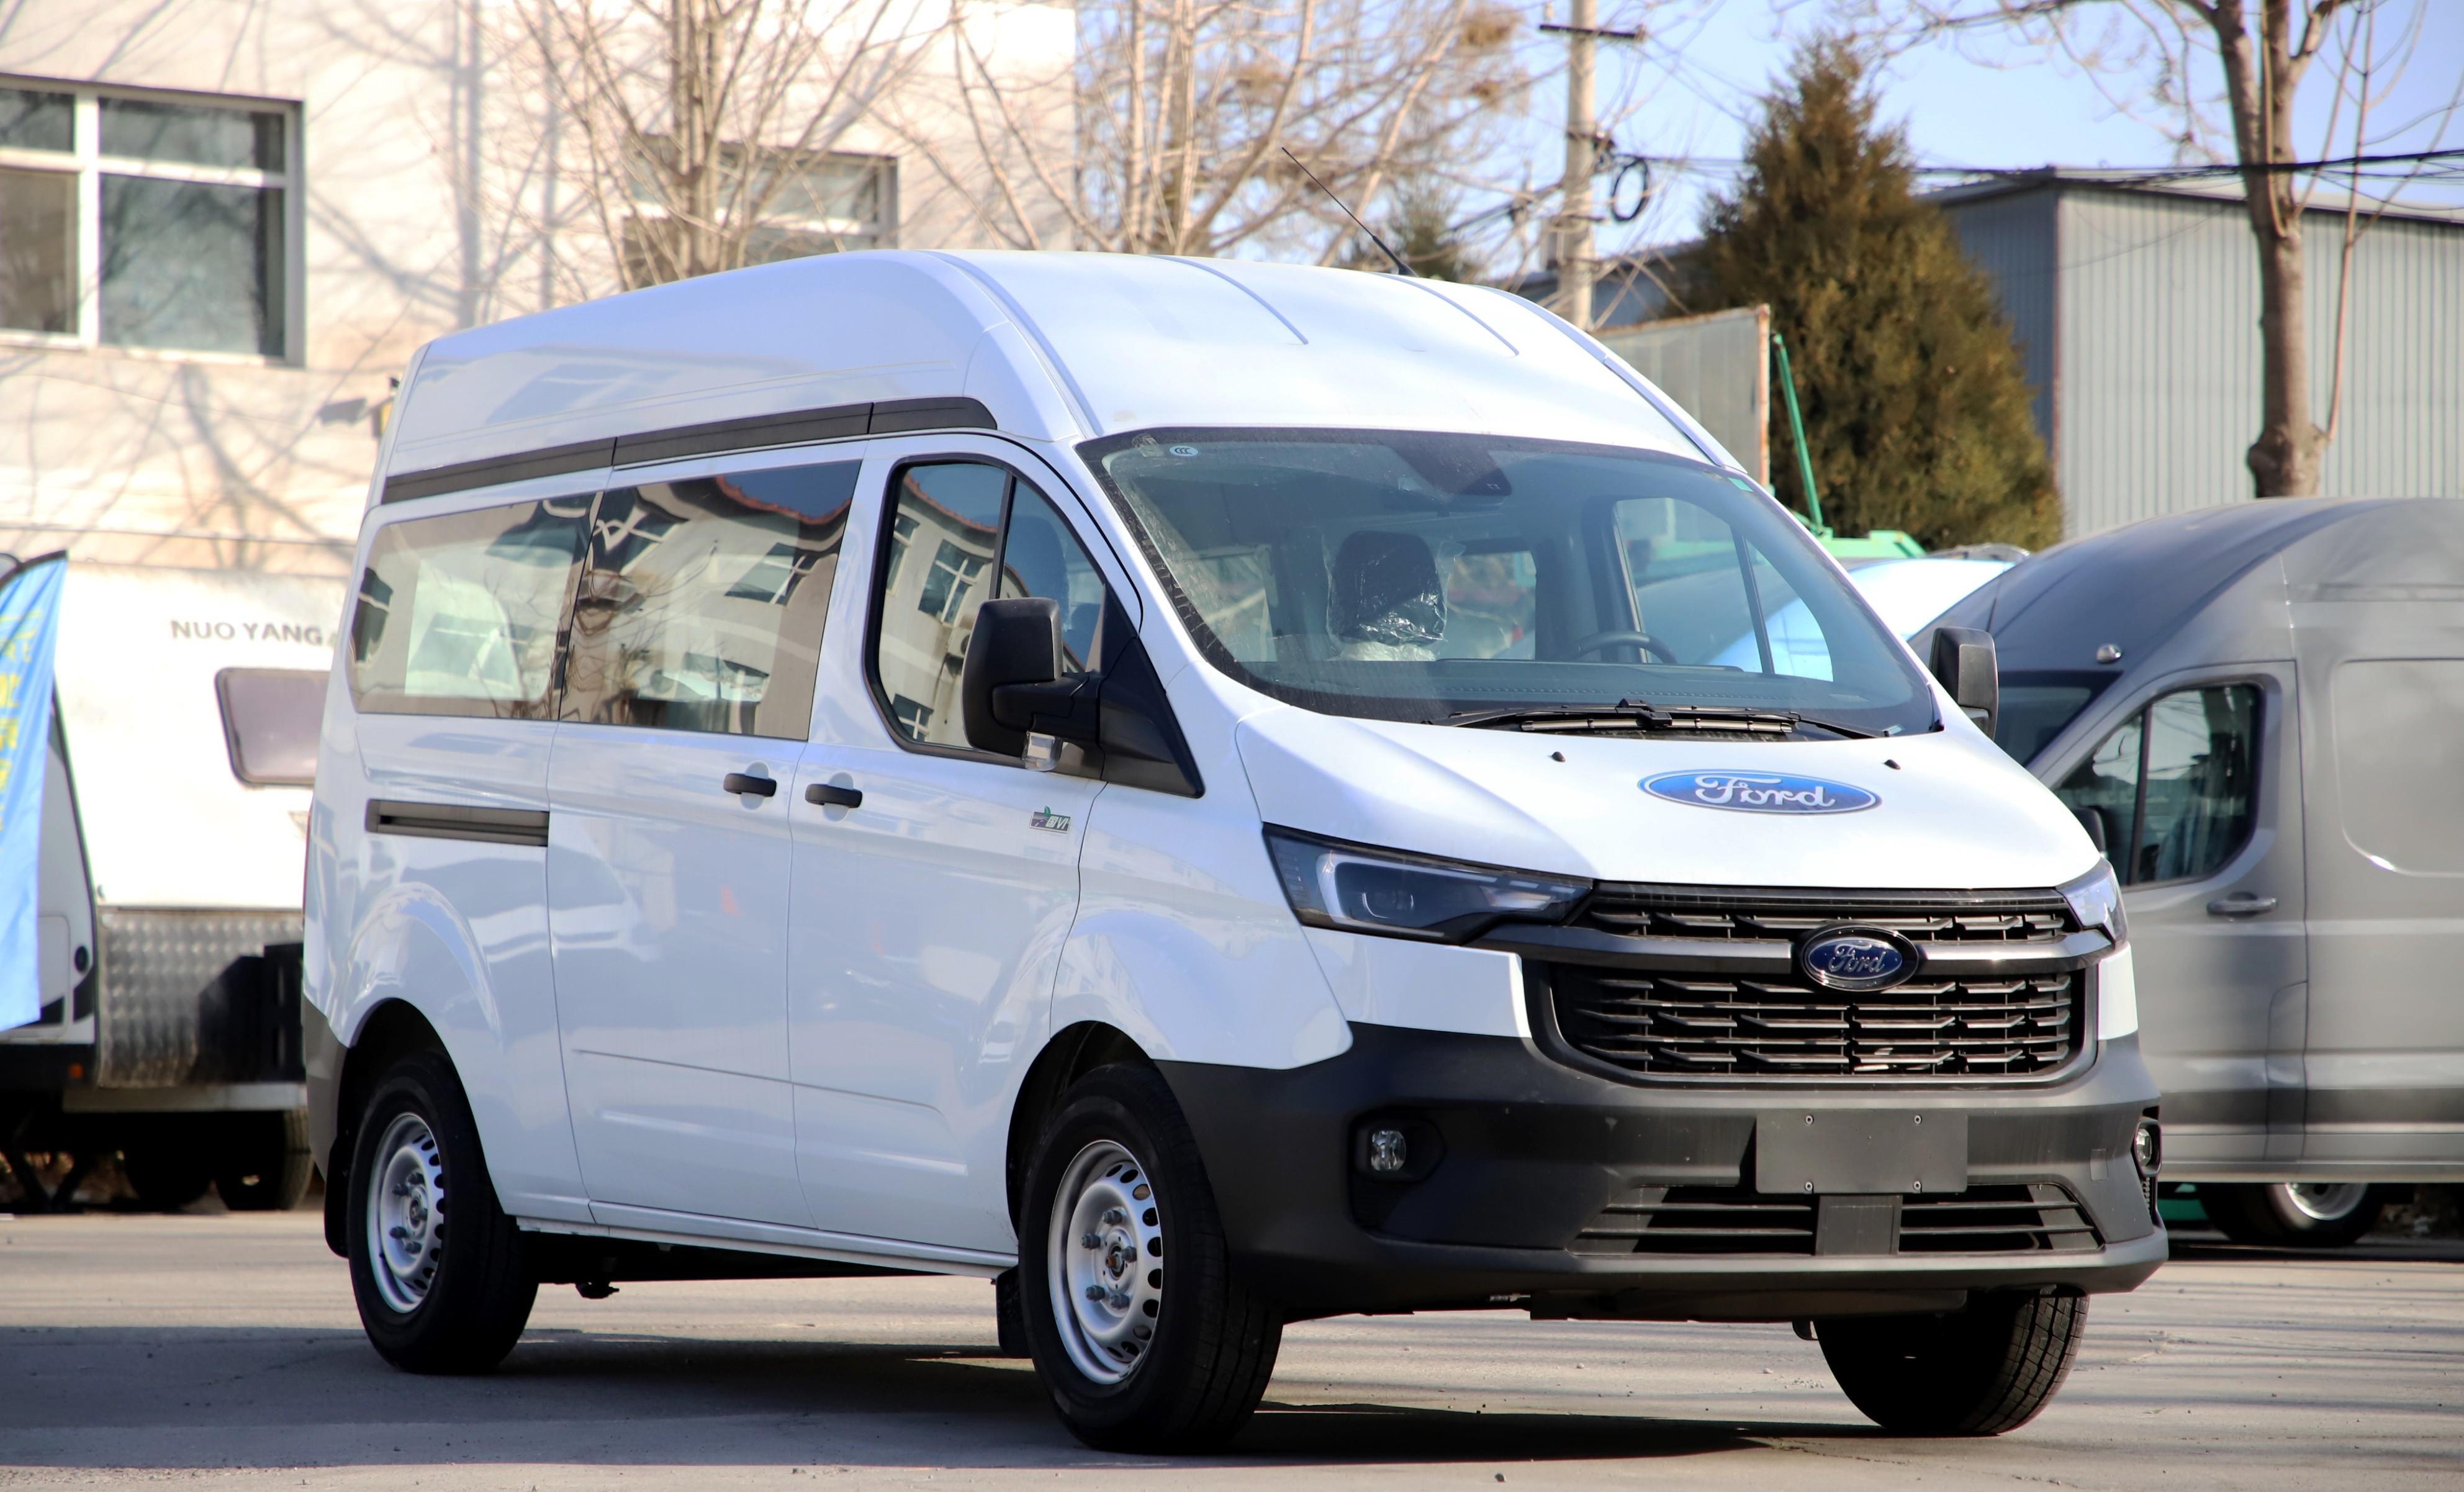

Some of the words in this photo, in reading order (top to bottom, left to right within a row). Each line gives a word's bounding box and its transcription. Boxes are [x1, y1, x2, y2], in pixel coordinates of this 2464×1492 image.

[170, 620, 236, 640] NUO
[242, 622, 323, 646] YANG
[1695, 775, 1836, 807] Ford
[1828, 943, 1886, 972] Ford
